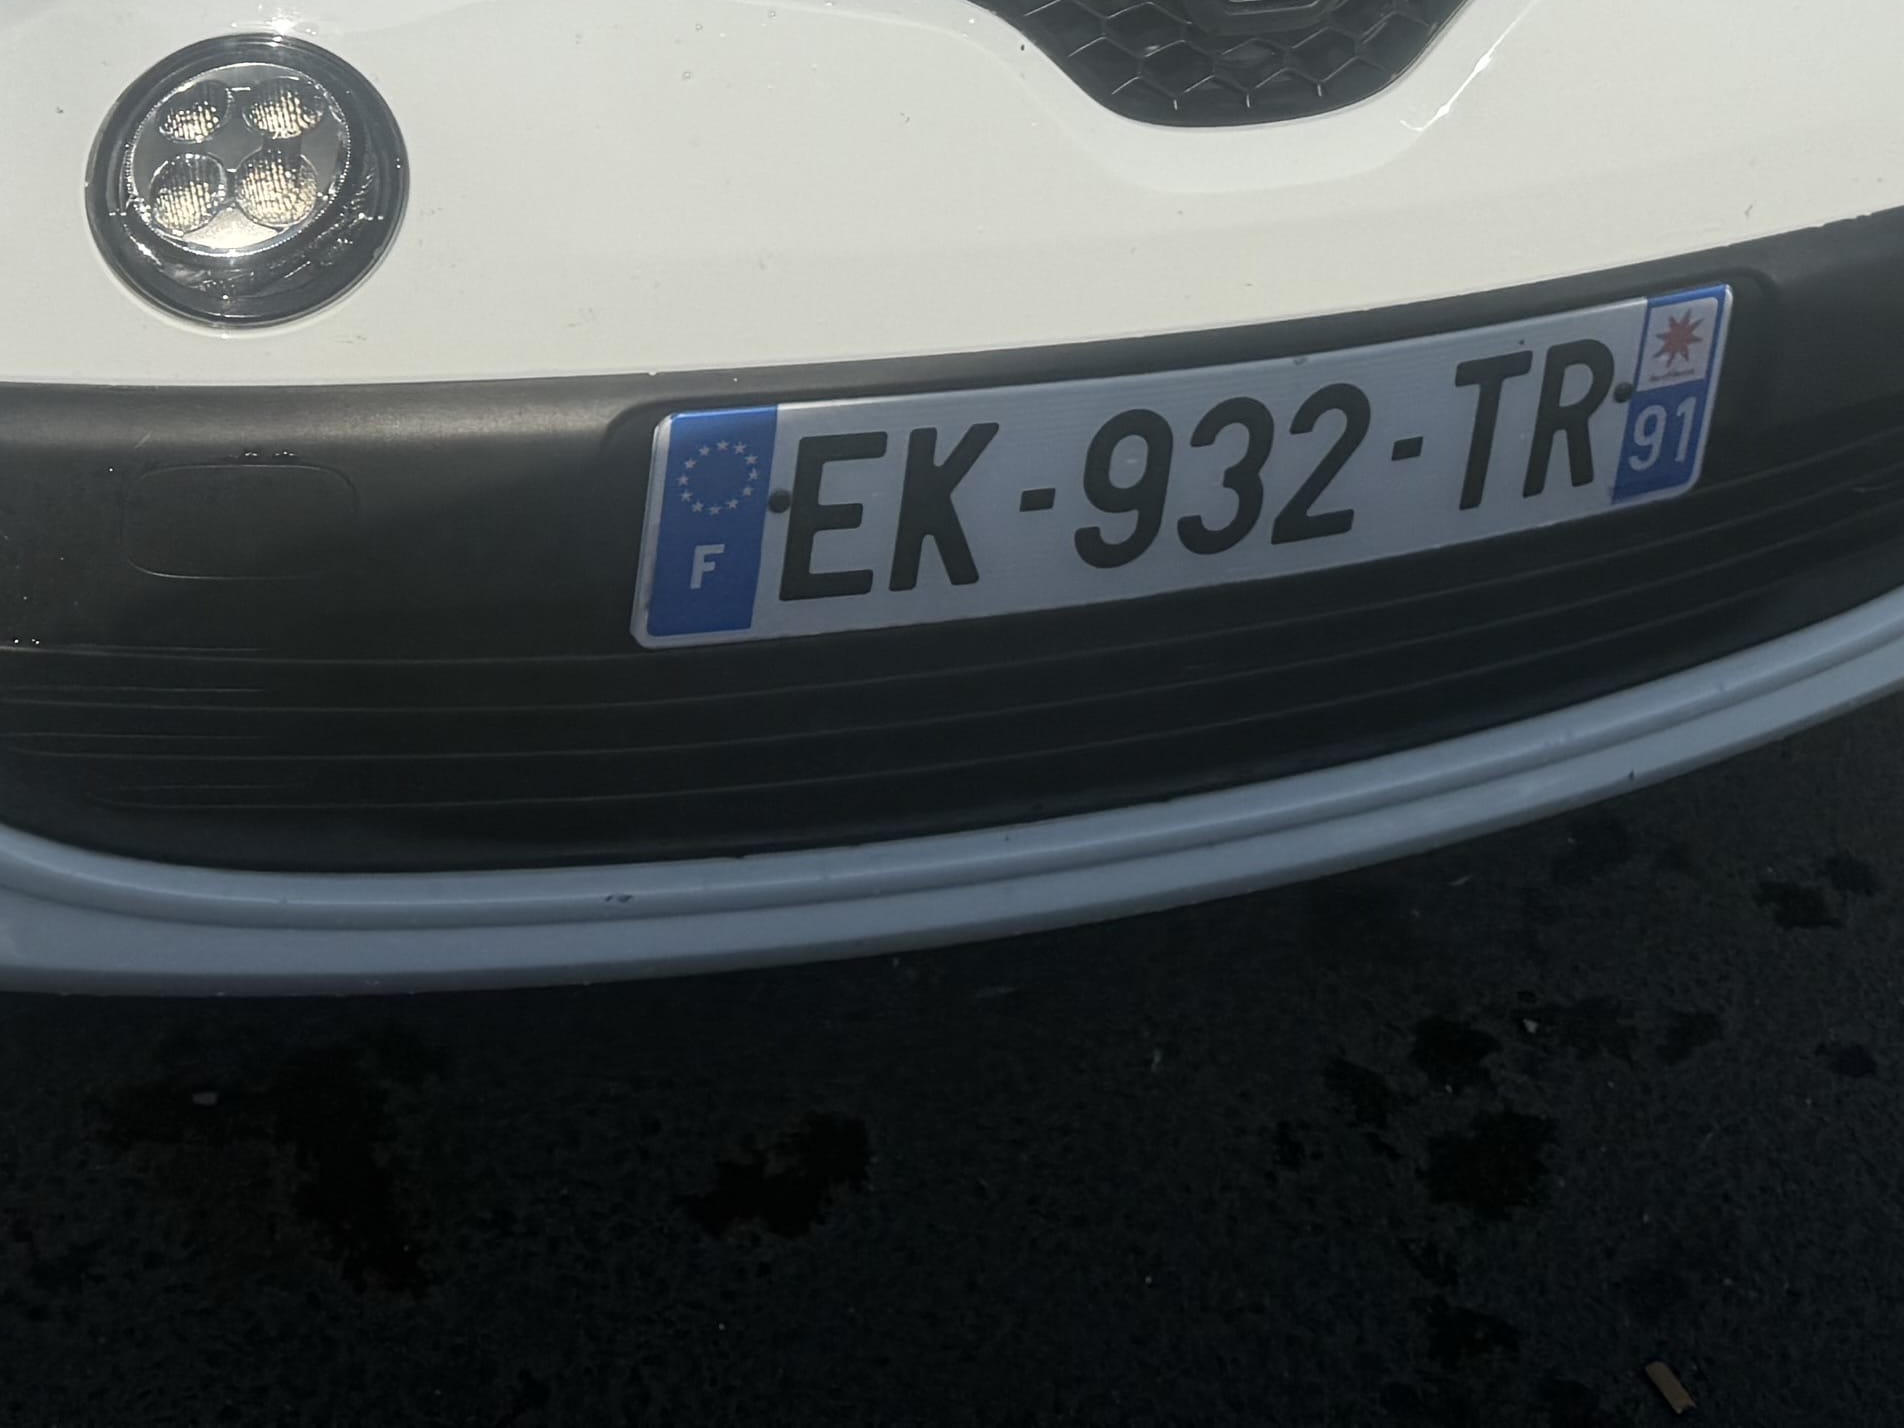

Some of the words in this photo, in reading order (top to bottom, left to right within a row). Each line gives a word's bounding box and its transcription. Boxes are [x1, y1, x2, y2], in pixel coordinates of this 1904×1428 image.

[778, 338, 1616, 602] EK-932-TR
[1628, 396, 1697, 472] 91
[690, 543, 726, 590] F
